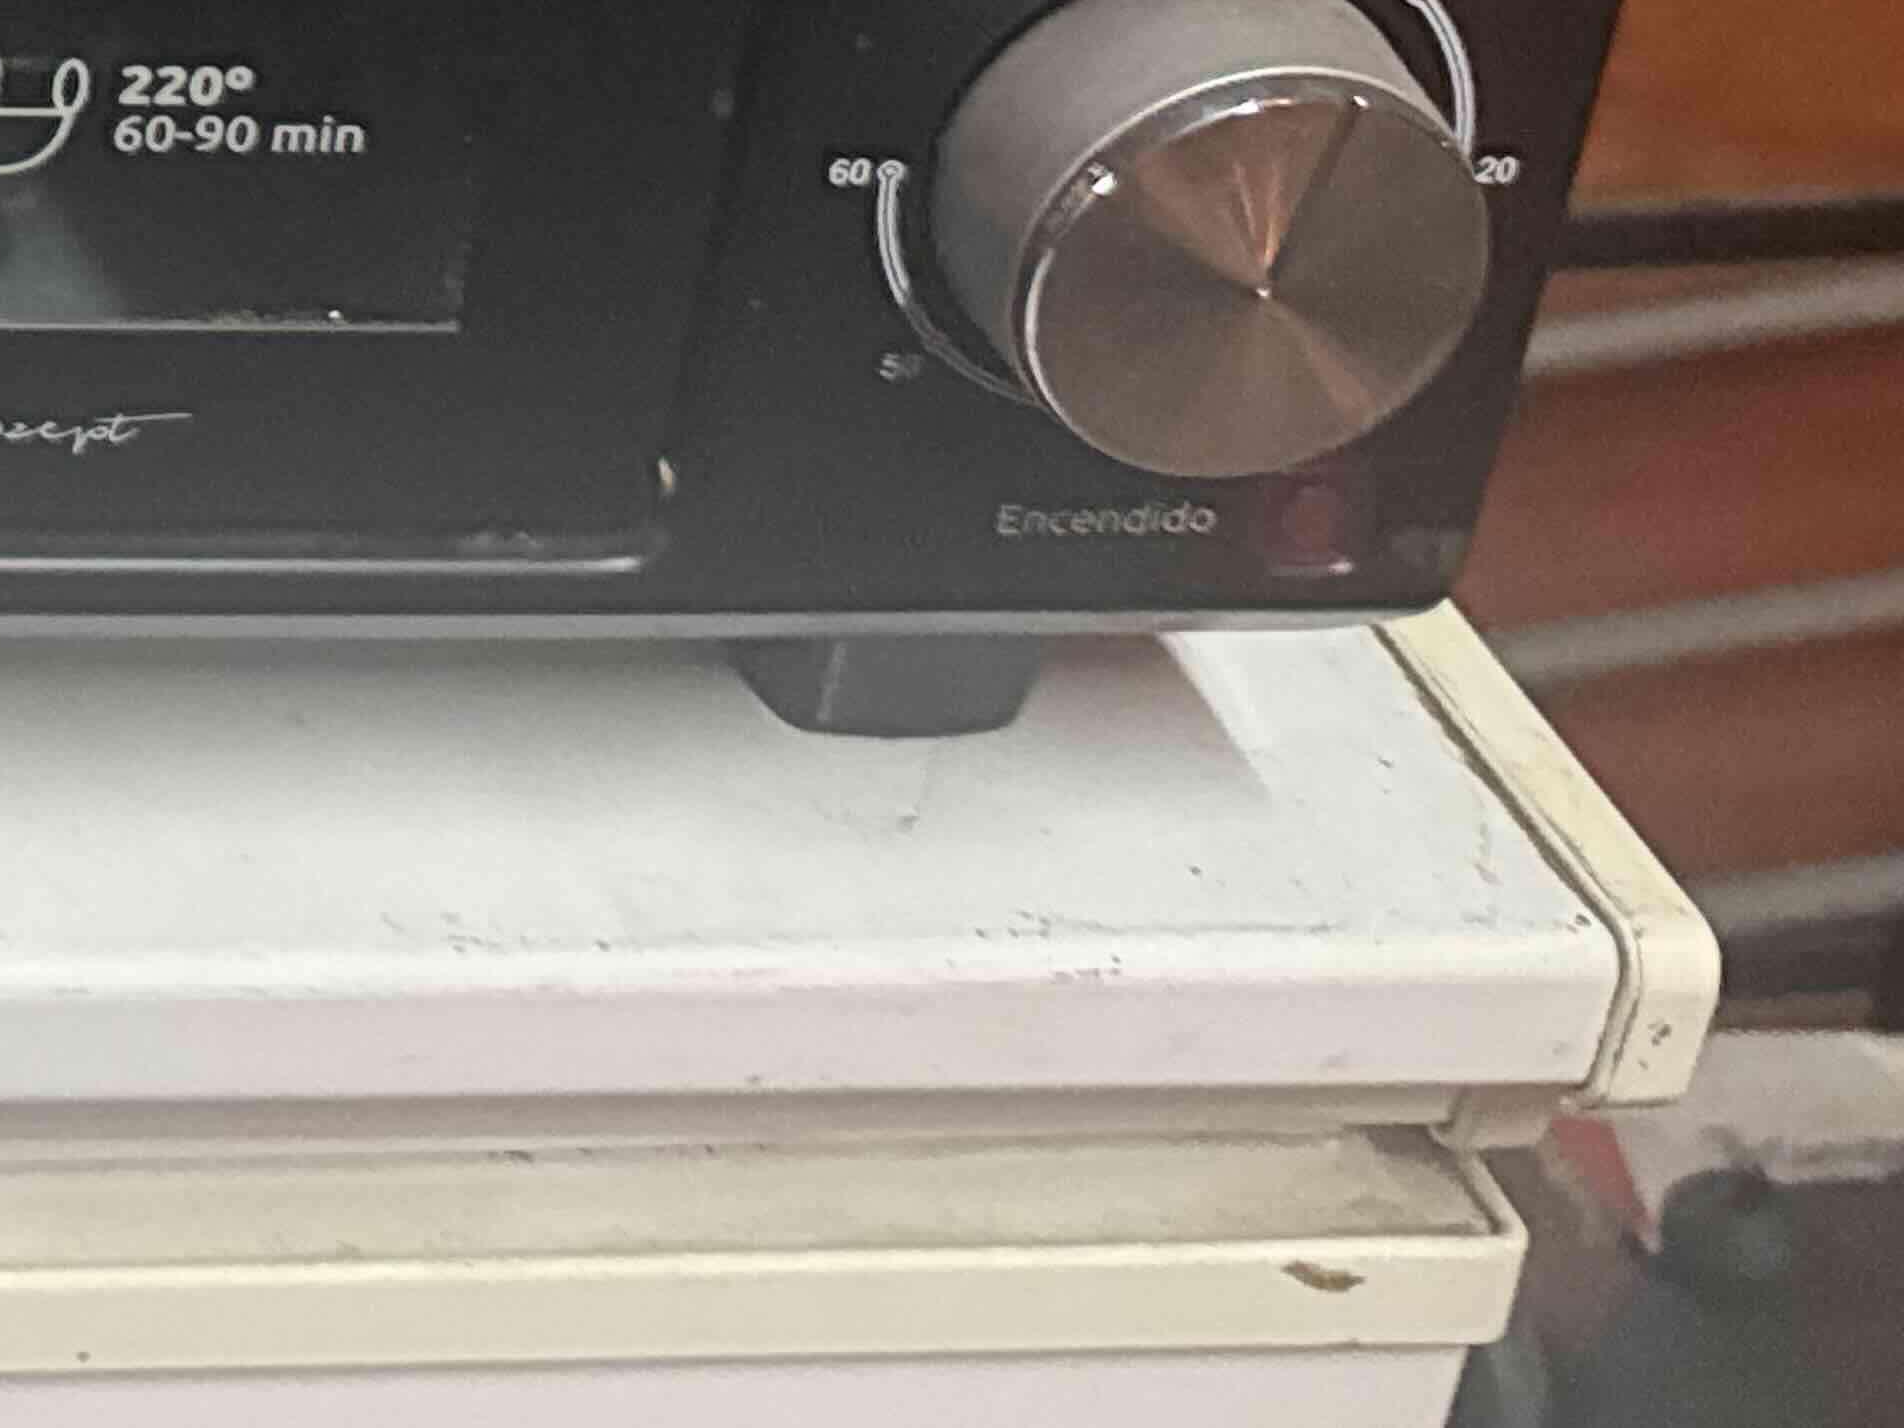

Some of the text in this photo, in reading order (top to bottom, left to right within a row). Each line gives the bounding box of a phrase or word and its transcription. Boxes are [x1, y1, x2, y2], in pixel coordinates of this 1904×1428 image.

[112, 113, 366, 155] 60-90 min
[827, 156, 873, 187] 60
[1474, 154, 1519, 185] 20
[995, 500, 1219, 538] Encendido
